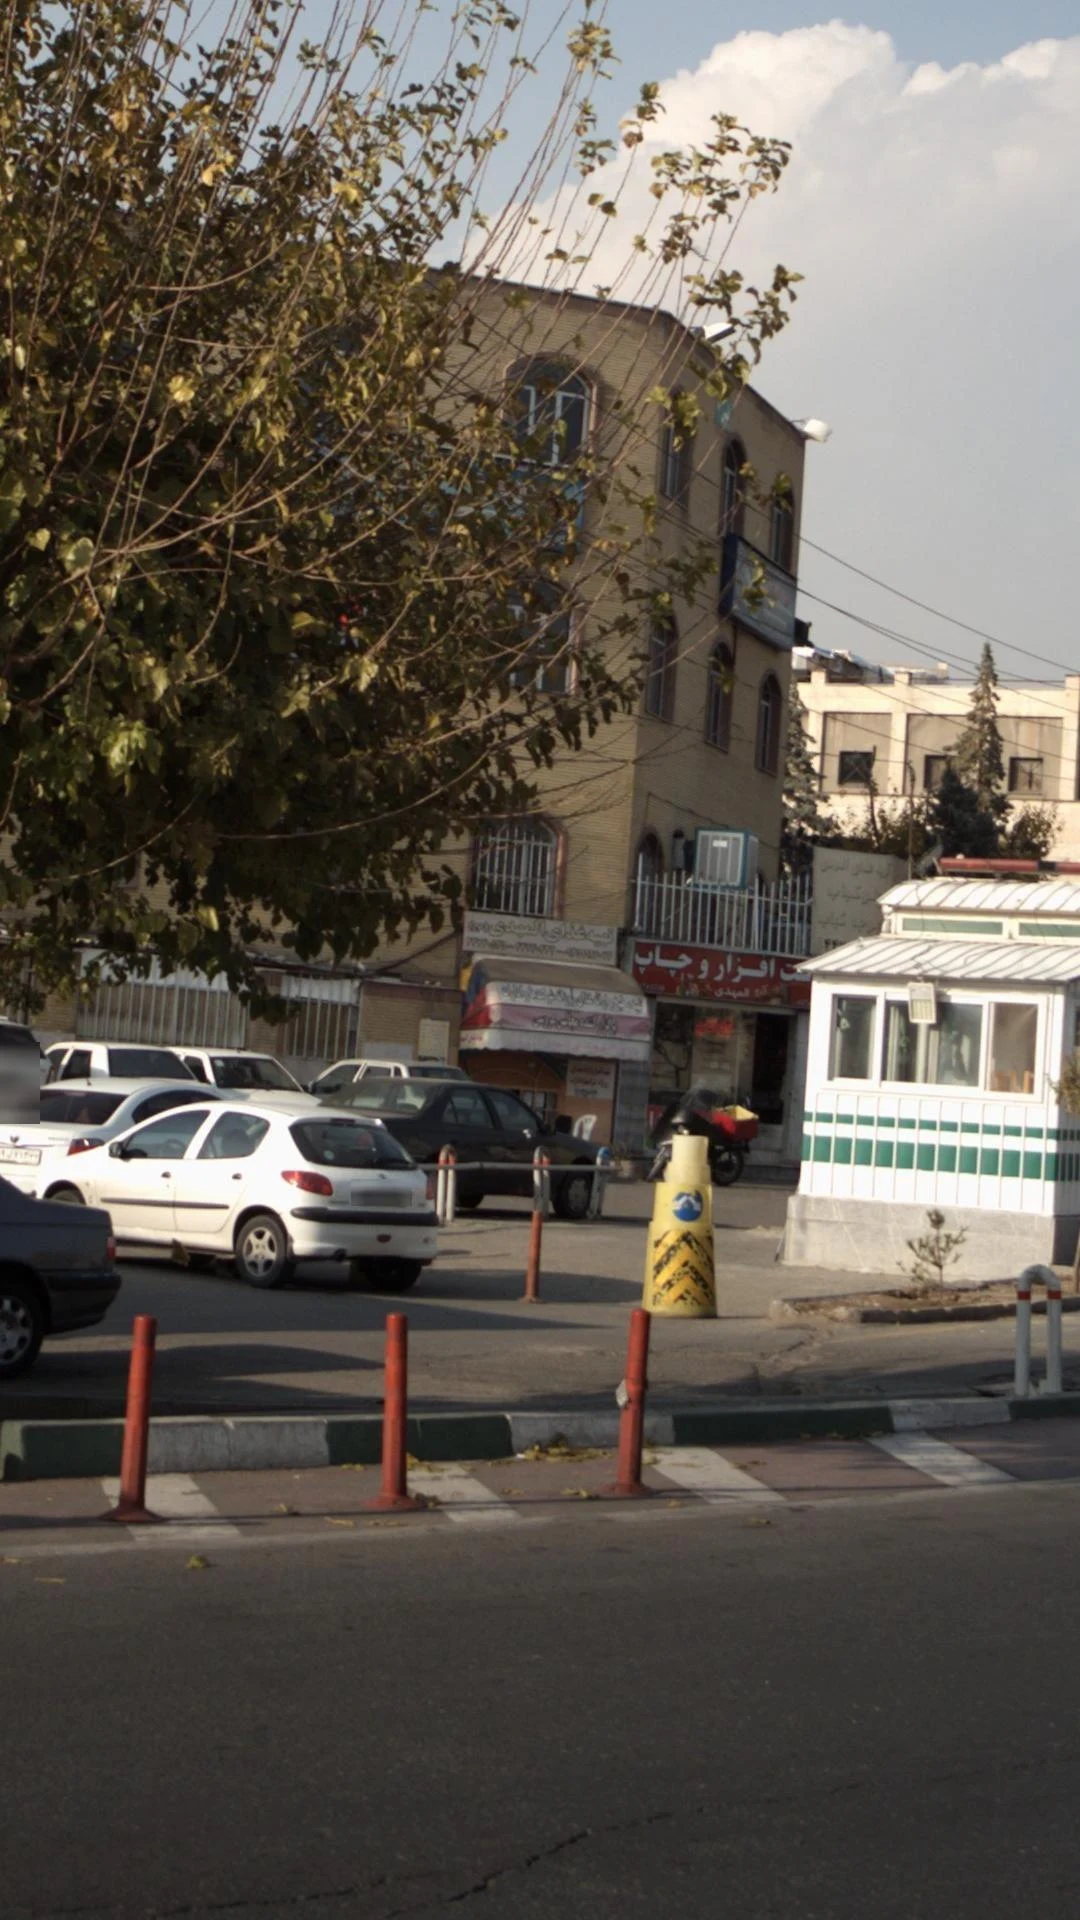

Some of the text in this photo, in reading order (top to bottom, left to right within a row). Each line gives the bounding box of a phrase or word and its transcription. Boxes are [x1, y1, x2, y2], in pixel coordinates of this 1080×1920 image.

[634, 945, 693, 977] چاپ
[698, 958, 708, 979] و
[714, 951, 776, 983] افزار
